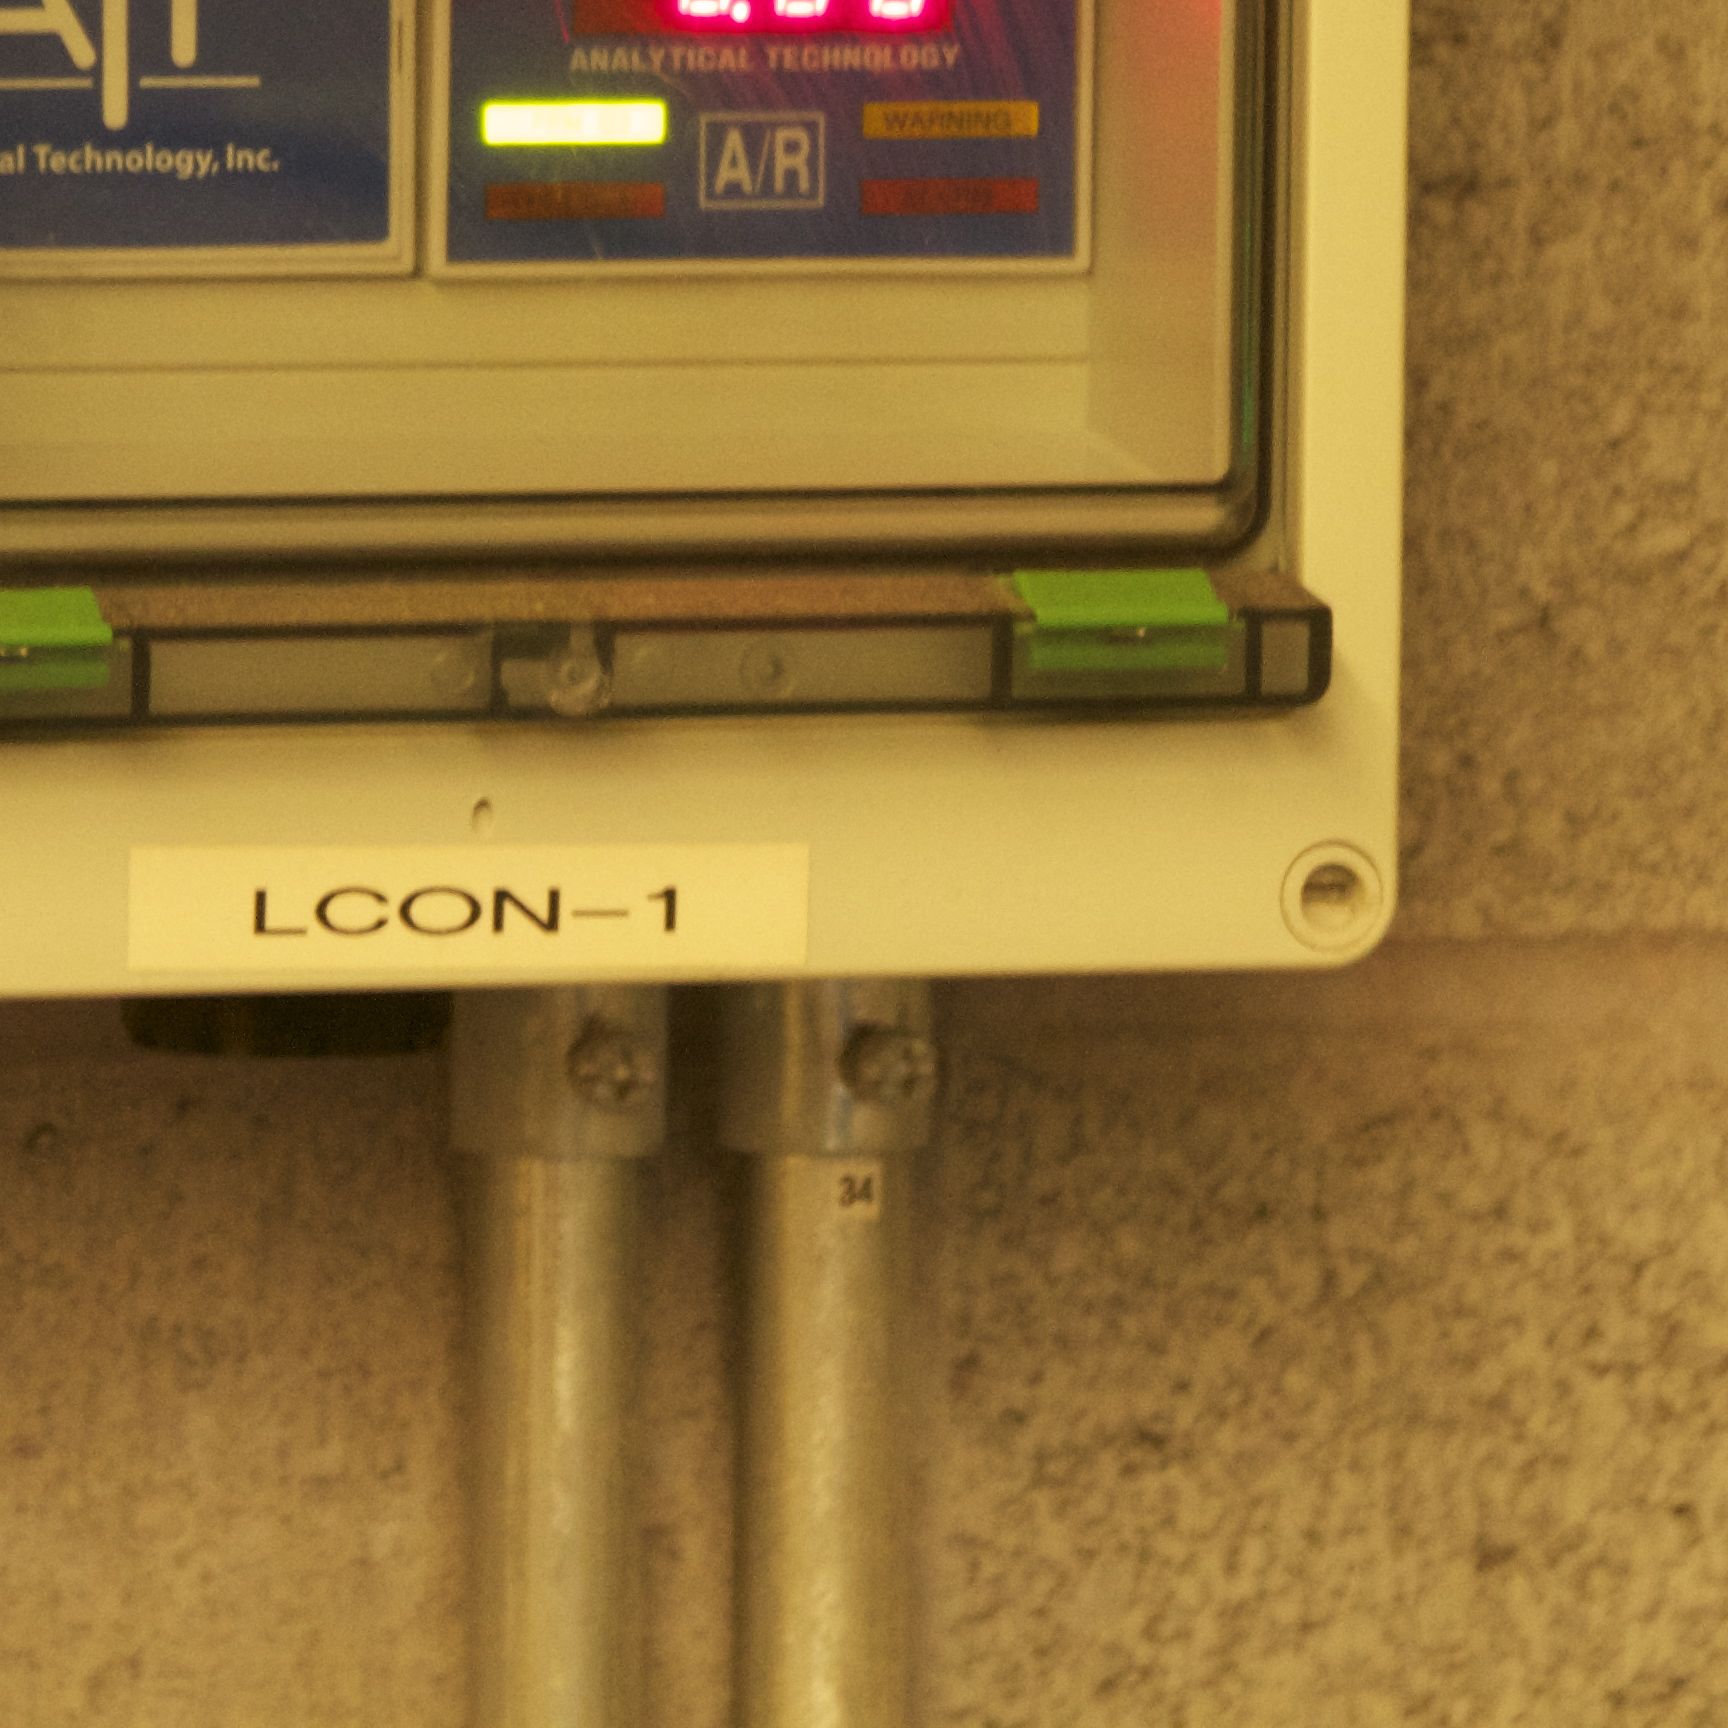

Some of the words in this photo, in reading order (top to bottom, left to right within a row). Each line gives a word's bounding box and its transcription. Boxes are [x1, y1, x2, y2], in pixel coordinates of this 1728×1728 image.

[571, 46, 750, 73] ANALYTICAL
[768, 42, 962, 72] TECHNOLOGY
[882, 110, 1014, 134] WARNING
[32, 142, 220, 181] Technology,
[226, 142, 280, 172] Inc.
[253, 886, 678, 936] LCON-1
